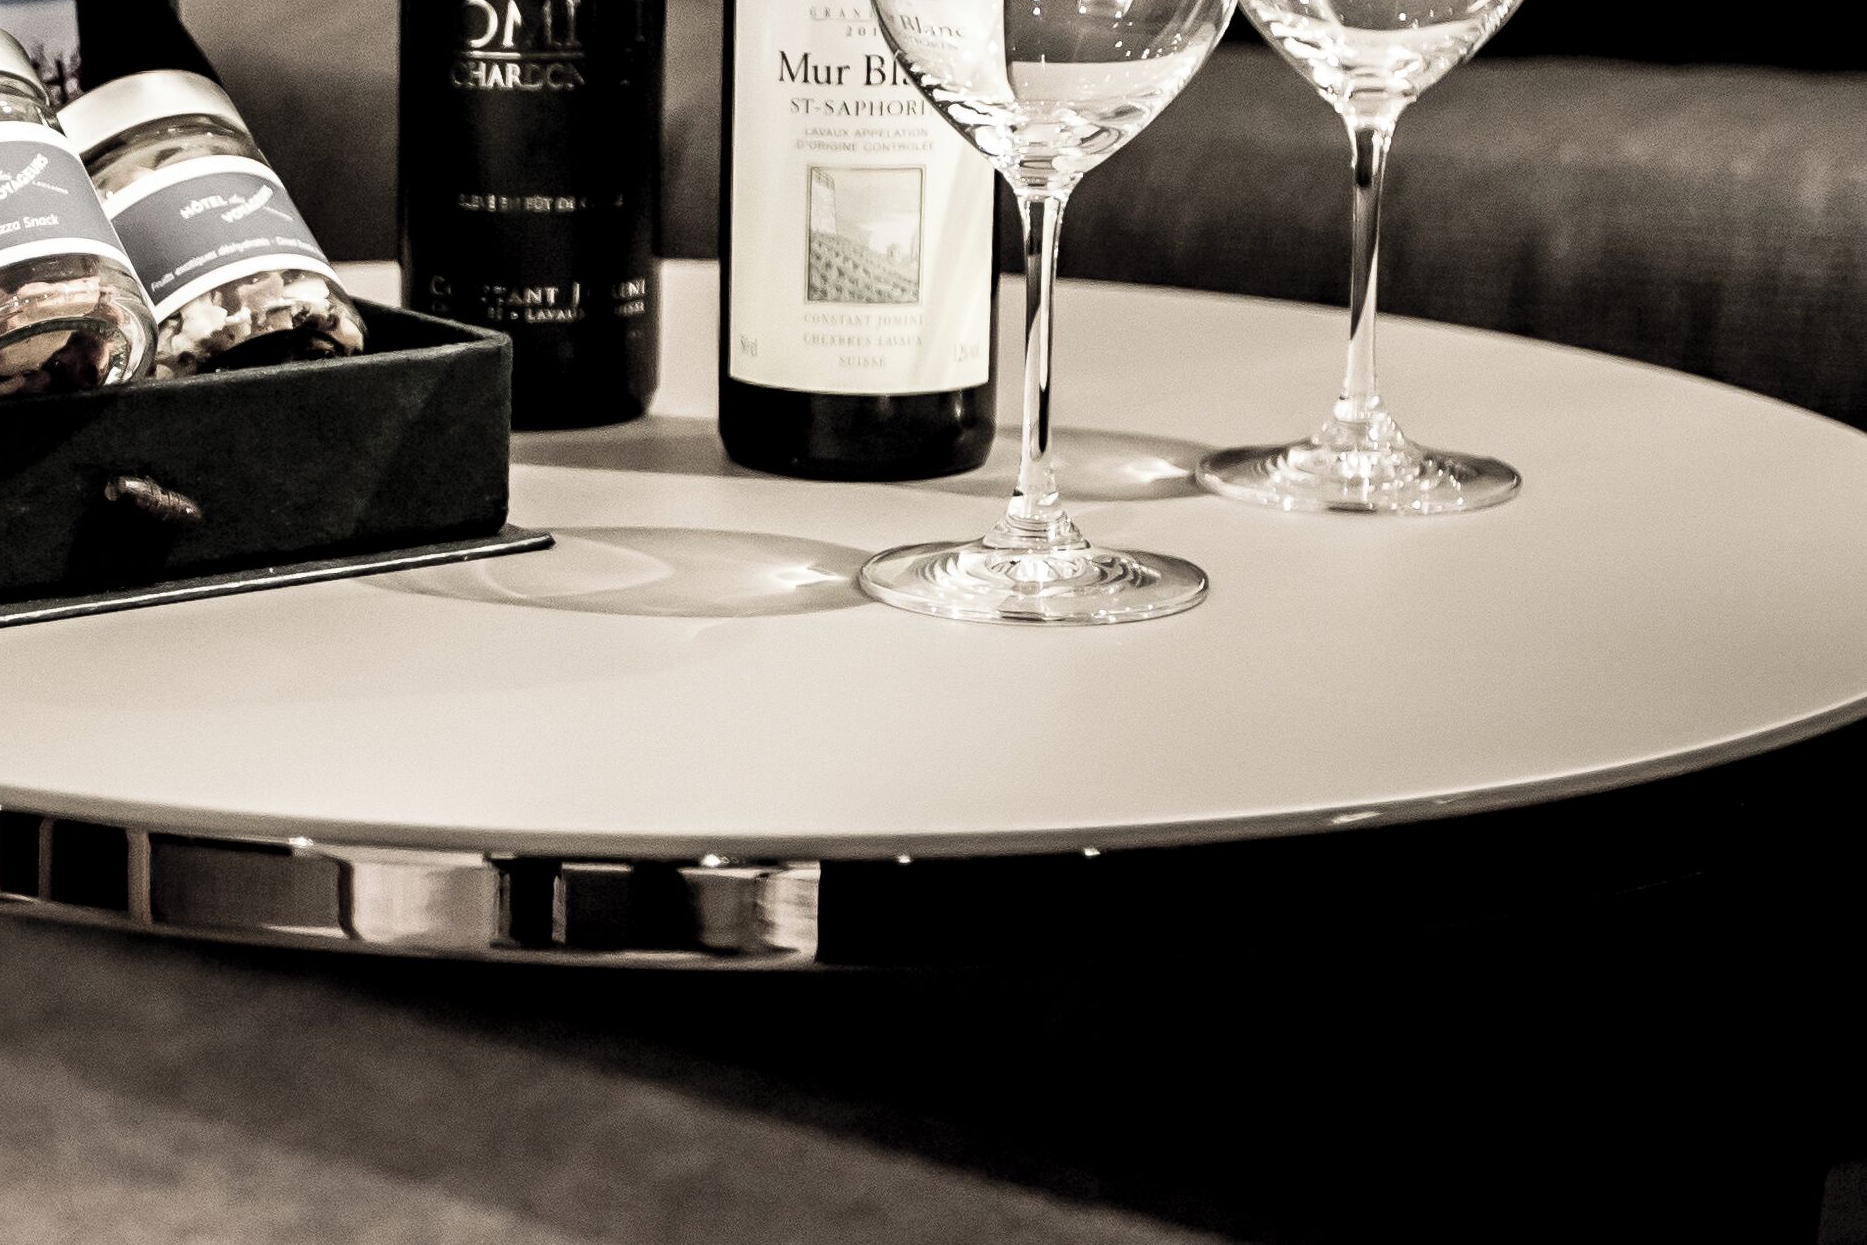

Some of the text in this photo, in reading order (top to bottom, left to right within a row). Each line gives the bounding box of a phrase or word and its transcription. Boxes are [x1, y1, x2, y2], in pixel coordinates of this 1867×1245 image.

[777, 49, 851, 86] Mur
[788, 97, 927, 117] ST-SAPHORI
[22, 213, 60, 229] Snack
